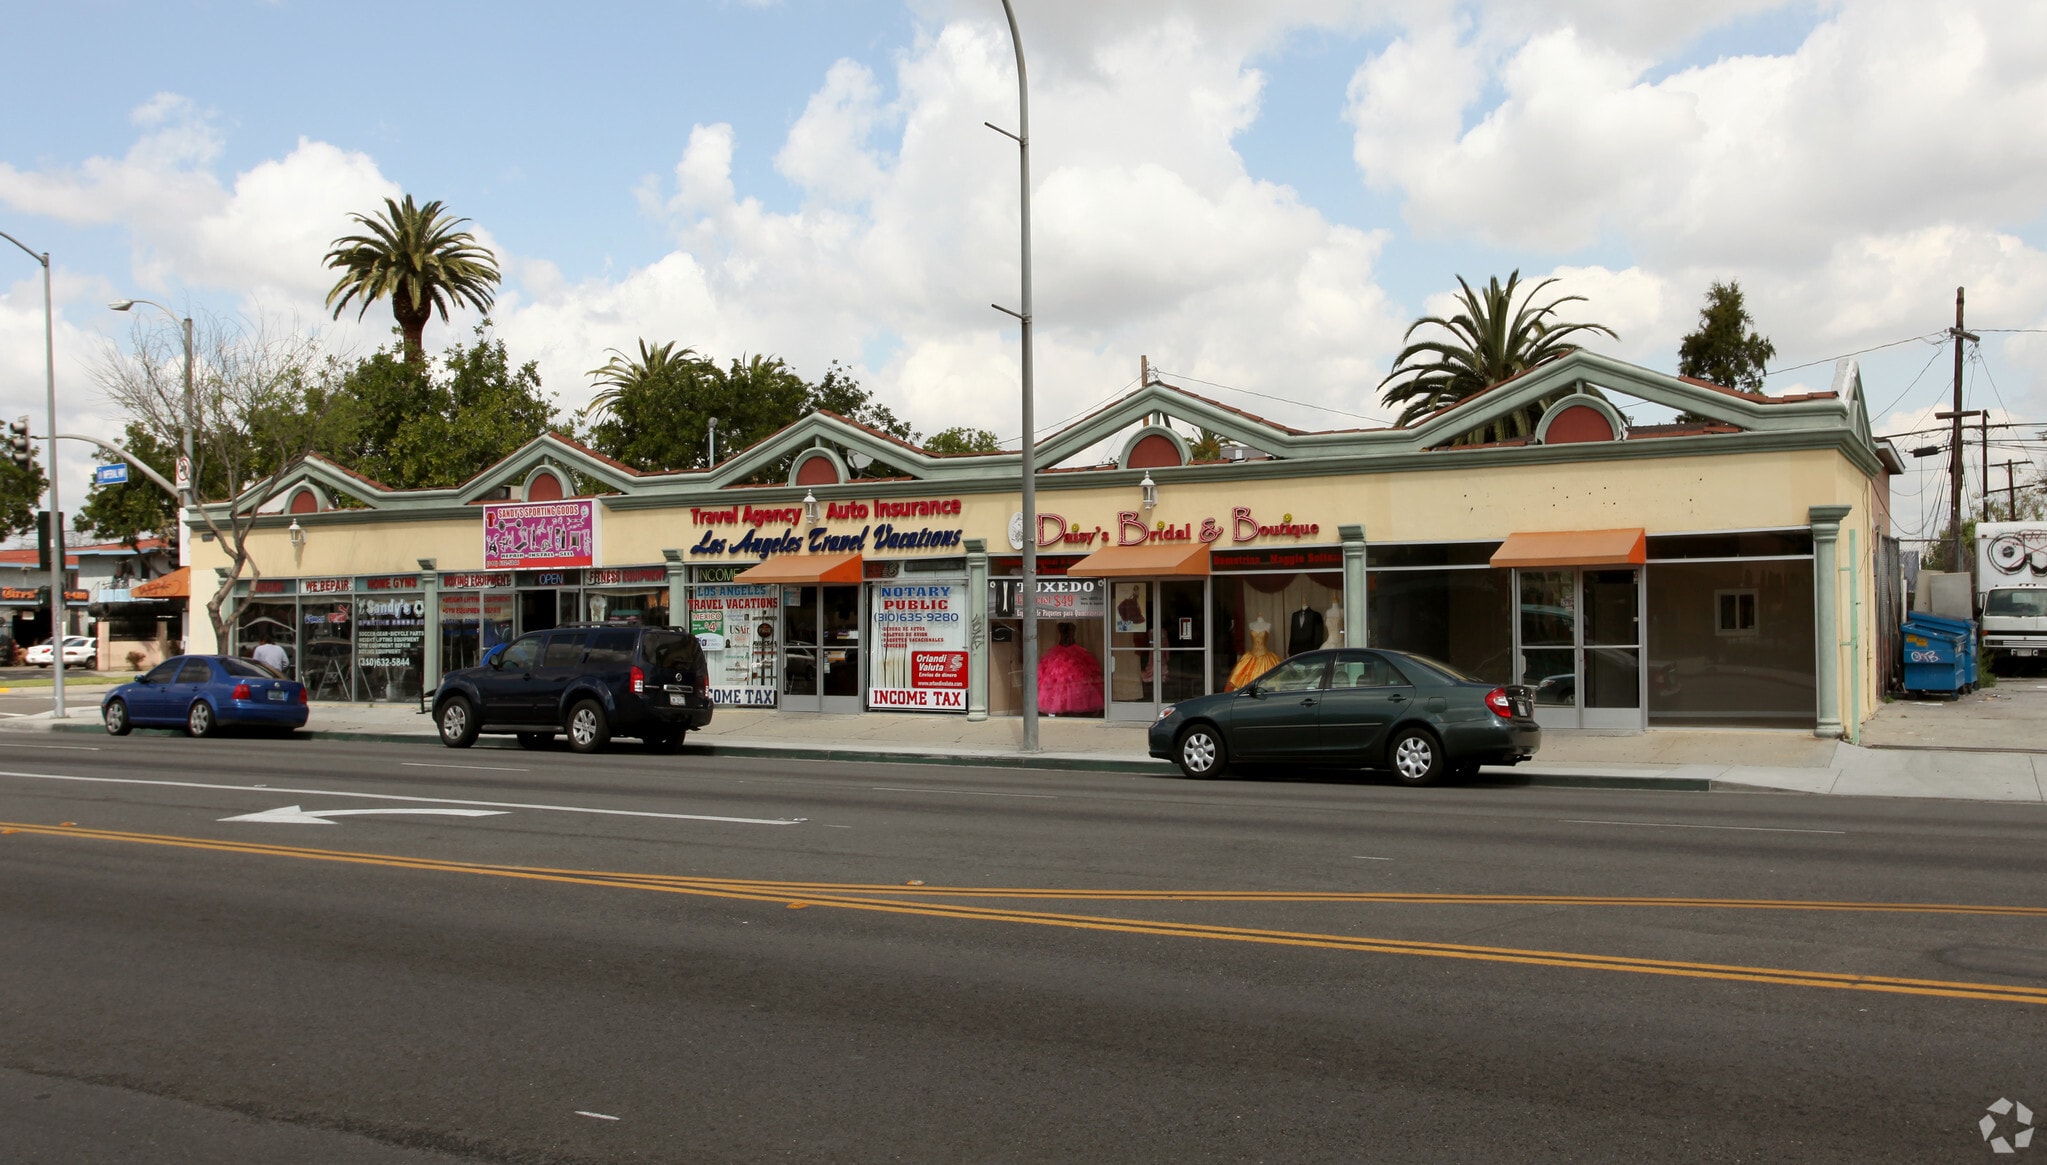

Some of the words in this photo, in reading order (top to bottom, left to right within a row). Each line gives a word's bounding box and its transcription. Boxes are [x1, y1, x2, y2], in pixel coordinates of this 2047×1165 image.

[498, 507, 524, 518] SANDY'S
[524, 506, 555, 517] SPORTING
[556, 504, 578, 515] GOODS
[690, 505, 738, 525] Travel
[742, 505, 802, 527] Agency
[826, 501, 869, 519] Auto
[873, 498, 962, 518] Insurance
[1036, 512, 1109, 547] Daisy's
[1117, 511, 1192, 546] Bridal
[1200, 517, 1224, 543] &
[1231, 505, 1320, 542] Boutique
[690, 529, 727, 555] Los
[729, 528, 804, 559] Angeles
[808, 524, 870, 552] Travel
[873, 523, 963, 550] Vacations
[367, 578, 391, 589] HOME
[393, 577, 417, 588] GYMS
[470, 574, 511, 587] EQUIPMENT
[540, 573, 564, 585] OPEN
[306, 581, 318, 593] WE
[320, 580, 349, 592] REPAIR
[697, 587, 716, 596] LOS
[719, 585, 767, 596] ANGELES
[881, 586, 951, 597] NOTARY
[366, 598, 411, 619] Sandy's
[687, 599, 723, 610] TRAVEL
[726, 597, 778, 610] VACATIONS
[883, 600, 948, 610] PUBLIC
[693, 612, 722, 620] MEXICO
[874, 612, 959, 622] (310)635-9280
[358, 657, 410, 668] (310)632-5844
[916, 654, 947, 663] Orlandi
[918, 663, 944, 672] Valuta
[745, 689, 773, 704] TAX
[873, 690, 928, 706] INCOME
[933, 691, 961, 706] TAX
